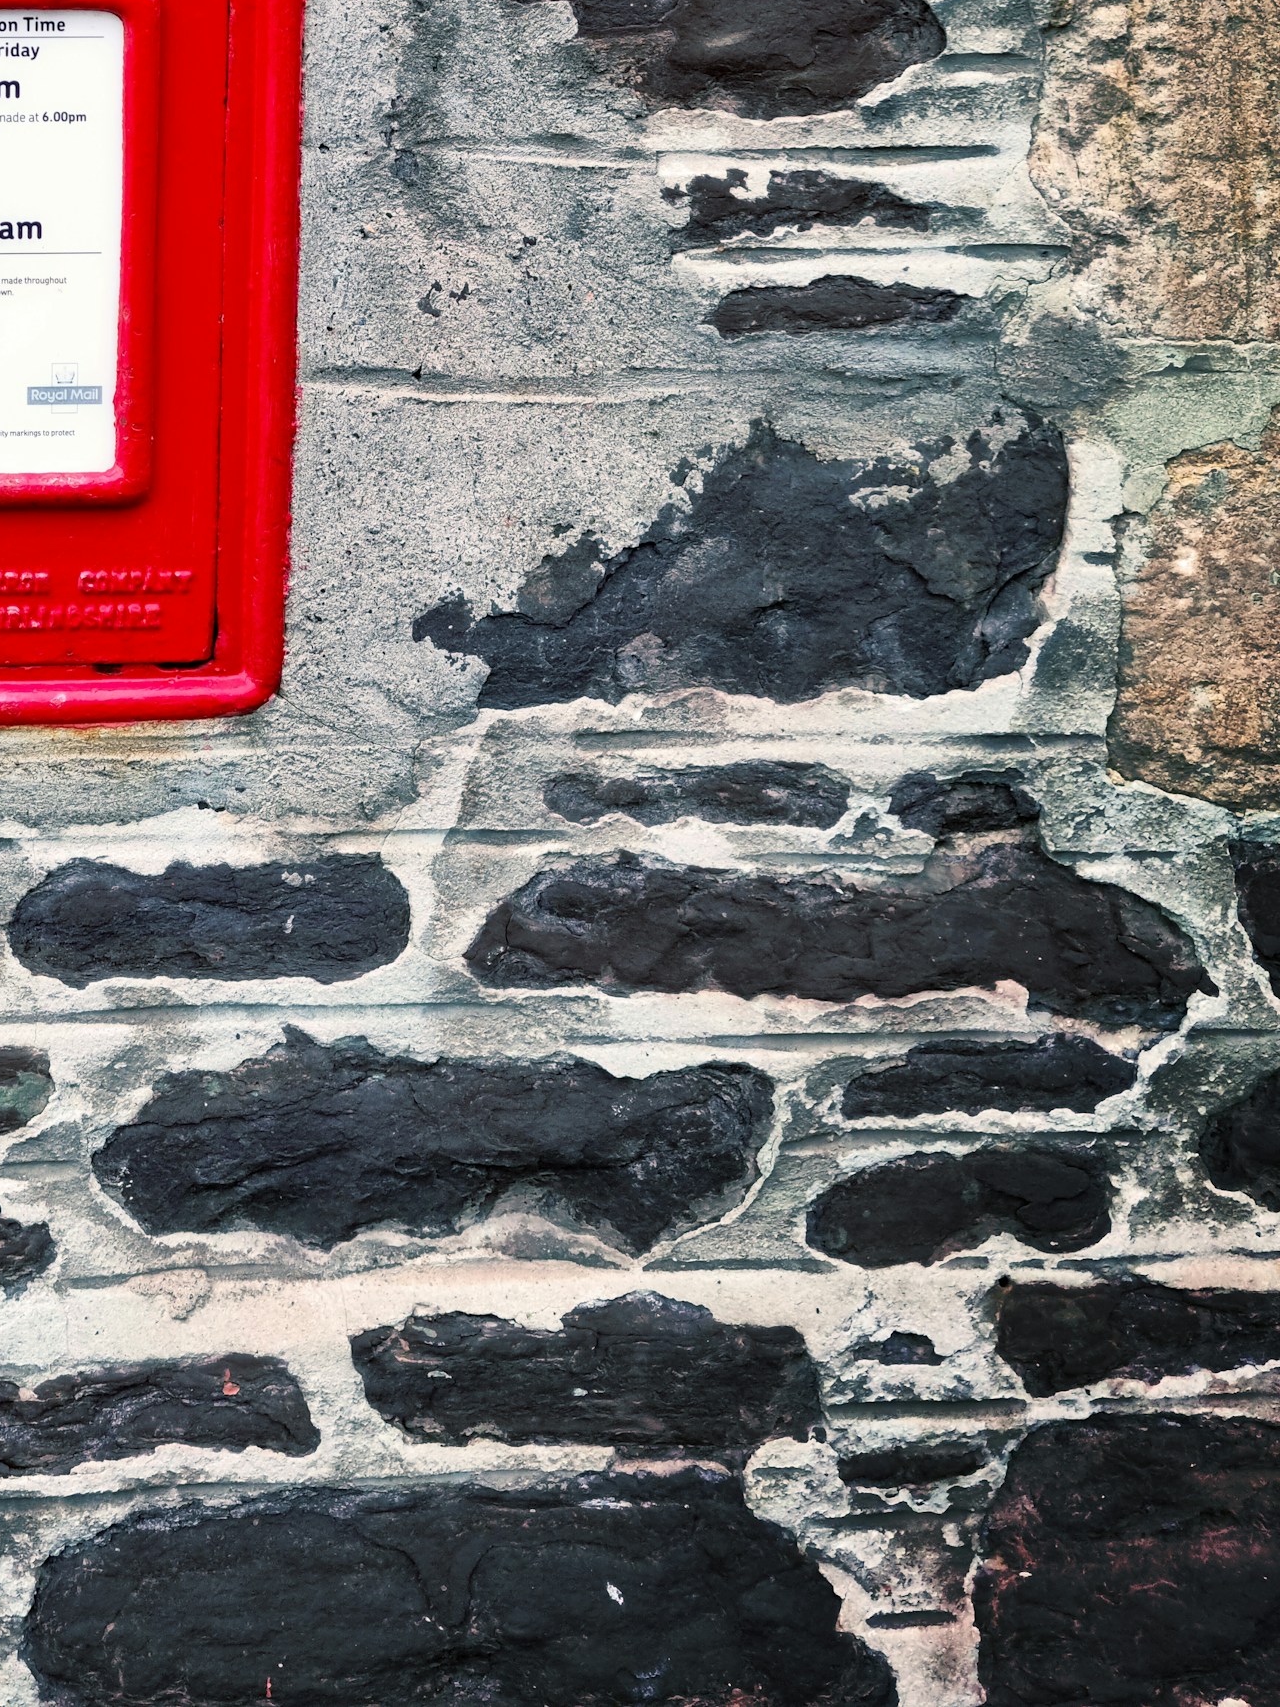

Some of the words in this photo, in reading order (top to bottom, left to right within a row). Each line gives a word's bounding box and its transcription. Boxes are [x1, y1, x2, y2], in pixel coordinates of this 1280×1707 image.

[22, 17, 65, 32] Time
[29, 113, 39, 122] at
[42, 111, 86, 124] 6.00pm
[24, 276, 67, 285] throughout
[31, 389, 67, 402] Royal
[70, 388, 99, 400] Mail
[10, 430, 41, 438] markings
